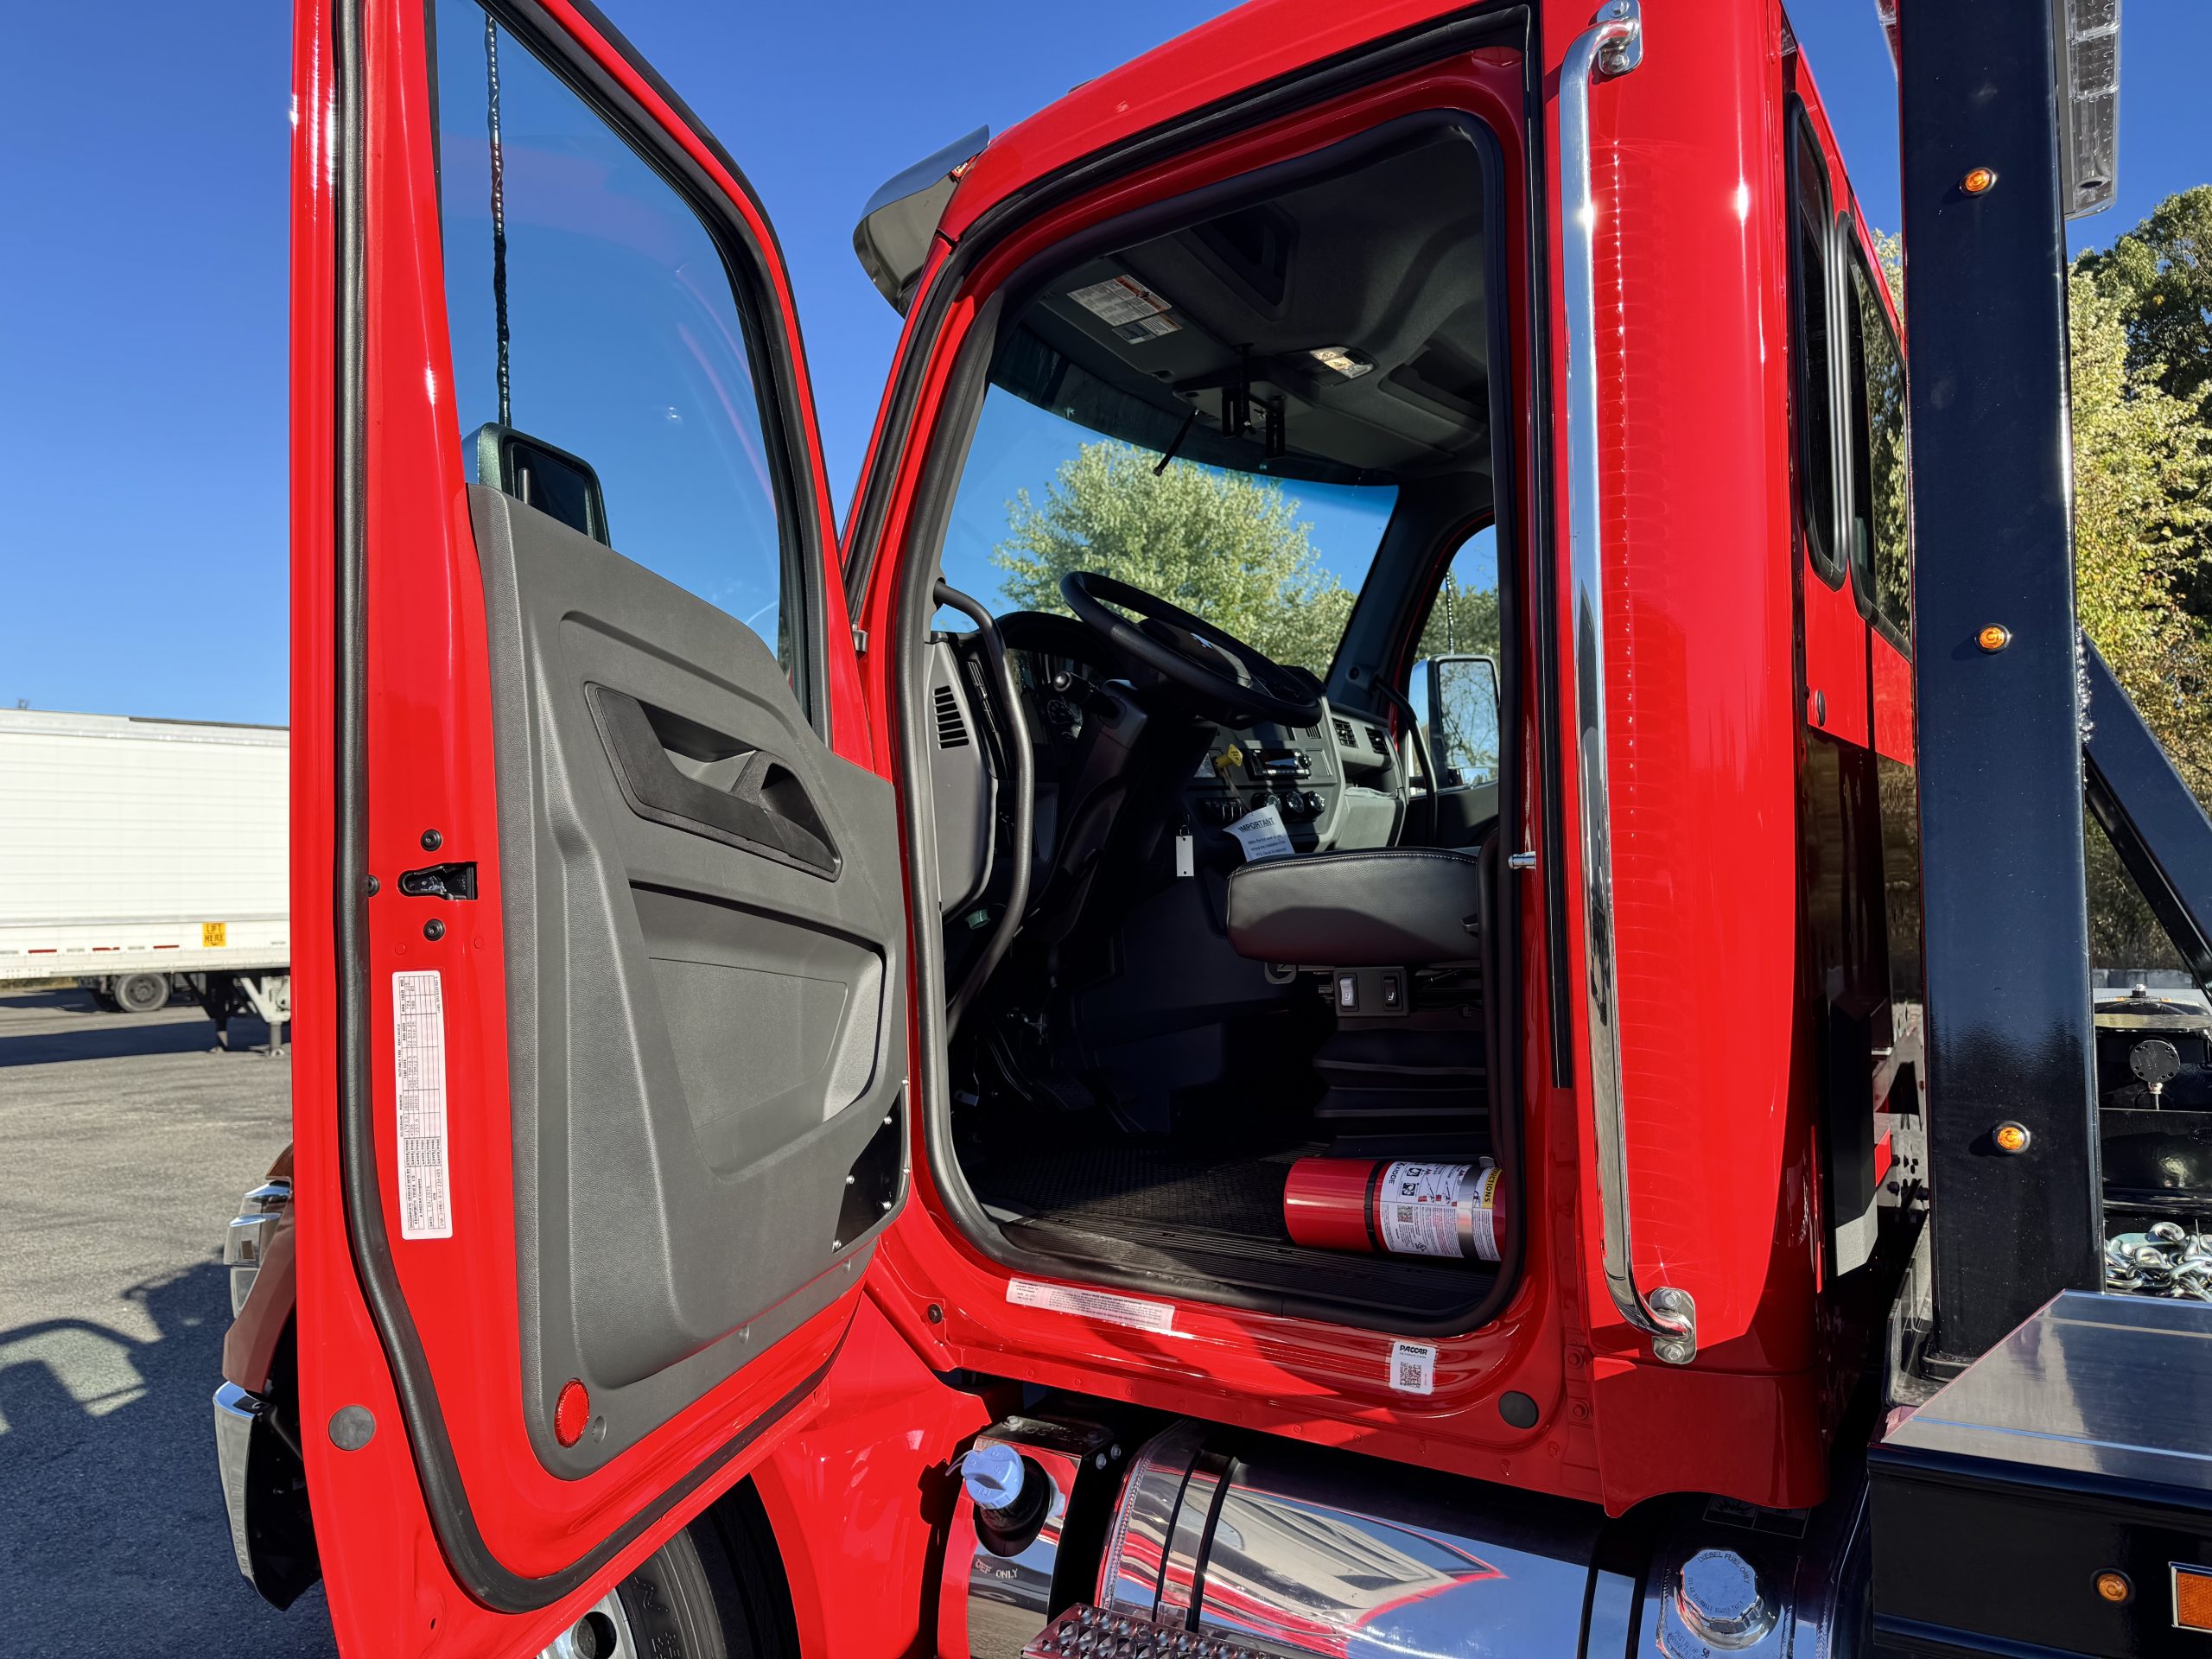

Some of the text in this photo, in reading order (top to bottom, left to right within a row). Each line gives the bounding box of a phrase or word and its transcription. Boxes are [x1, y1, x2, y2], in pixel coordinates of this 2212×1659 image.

[1238, 817, 1275, 833] IMPORTANT
[1389, 1166, 1400, 1184] KIDDE
[1484, 1168, 1501, 1202] TRUCTIONS
[1400, 1345, 1427, 1355] PACCAR
[996, 1568, 1018, 1579] ONLY
[1698, 1551, 1750, 1584] DIESEL FUEL ONLY
[1701, 1647, 1710, 1658] 50
